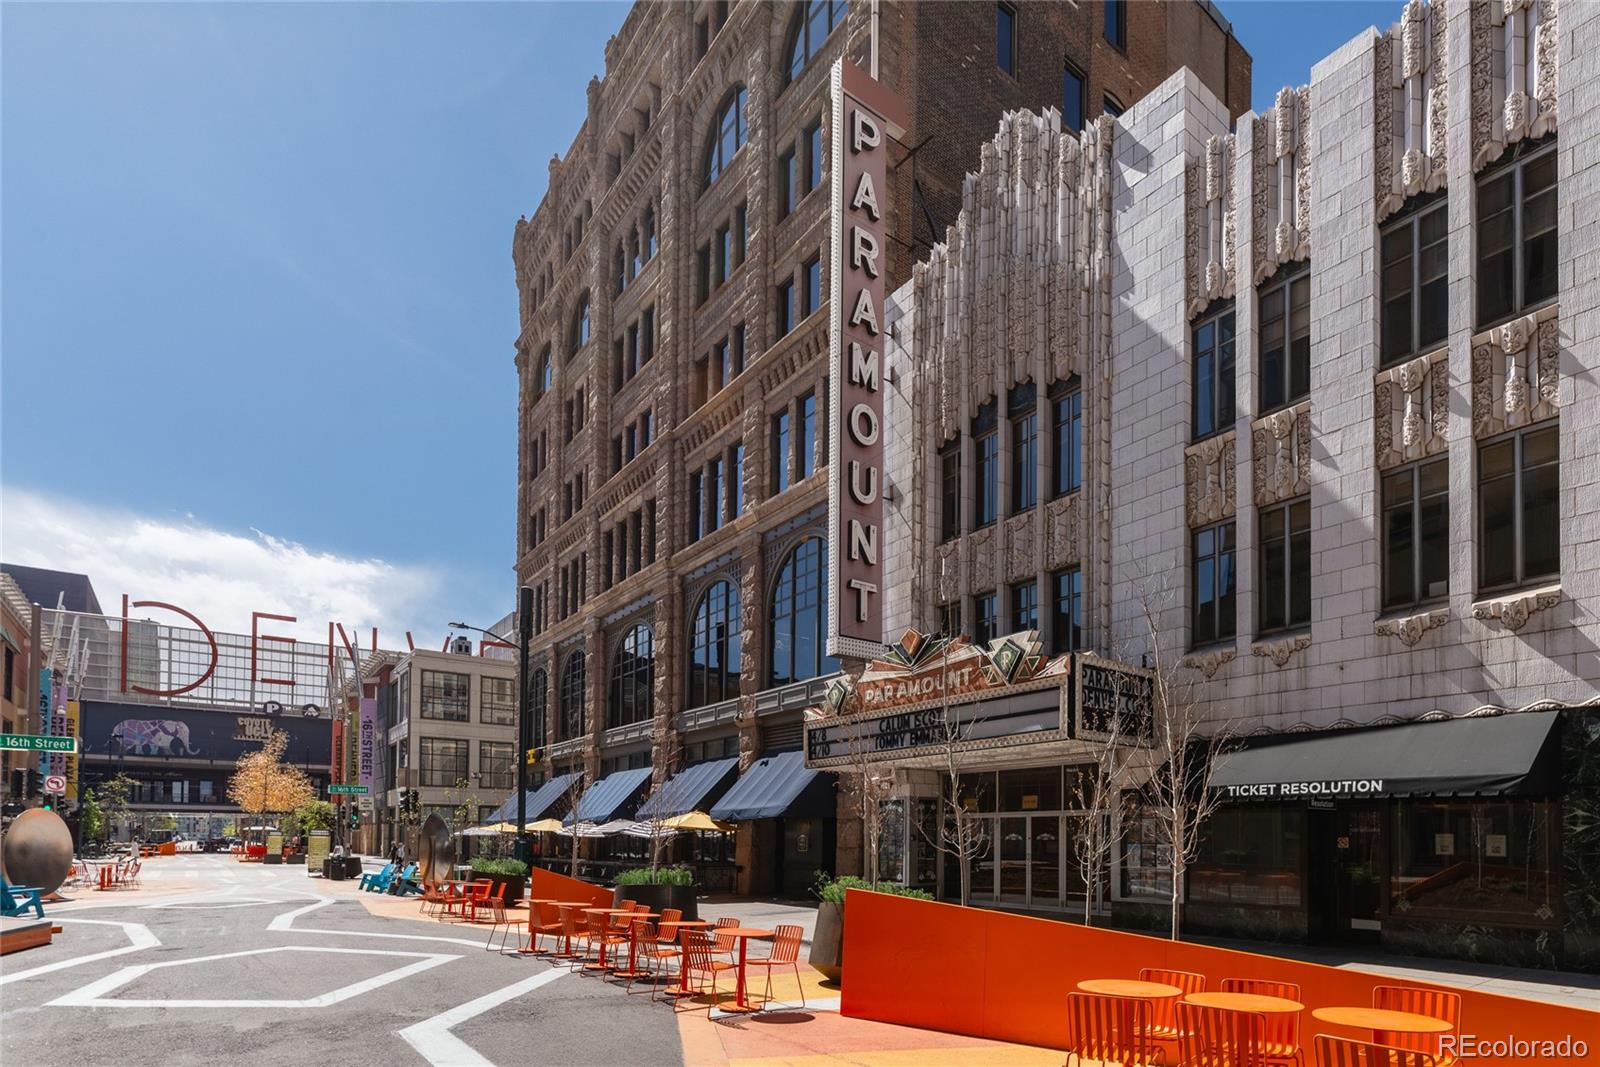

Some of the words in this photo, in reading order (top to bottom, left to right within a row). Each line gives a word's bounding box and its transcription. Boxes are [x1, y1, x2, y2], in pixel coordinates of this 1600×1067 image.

[849, 108, 881, 623] PARAMOUNT
[865, 666, 973, 703] PARAMOUNT
[1082, 668, 1144, 697] PARAOU
[237, 717, 271, 728] COYOTE
[879, 714, 911, 732] CALUM
[914, 709, 946, 727] SCOT
[6, 737, 31, 748] 16th
[35, 738, 70, 749] Street
[874, 733, 906, 751] TOMMY
[910, 725, 962, 746] EMMANL
[1227, 784, 1276, 797] TICKET
[1280, 780, 1383, 795] RESOLUTION
